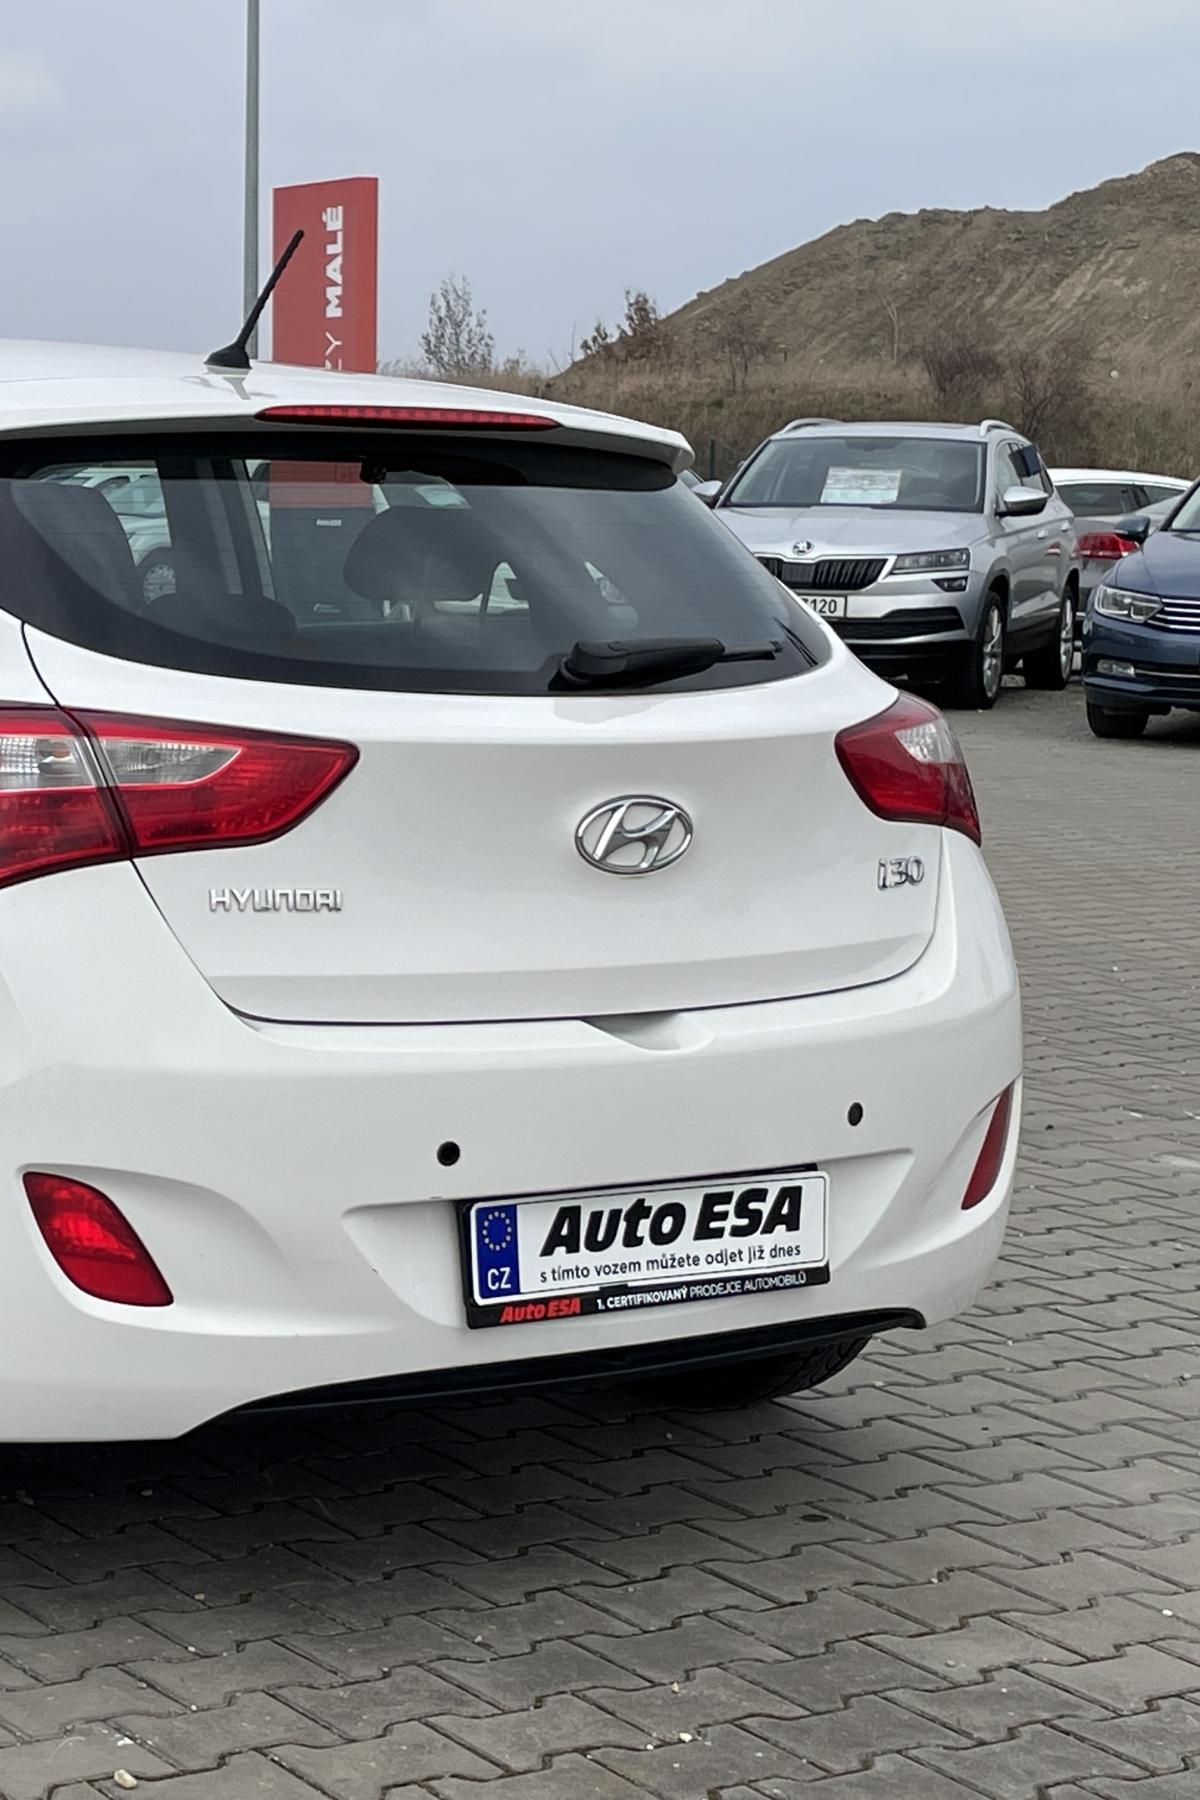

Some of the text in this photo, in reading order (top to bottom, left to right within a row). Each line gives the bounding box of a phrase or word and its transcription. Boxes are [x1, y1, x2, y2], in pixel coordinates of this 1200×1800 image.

[322, 205, 344, 319] MALÉ
[801, 598, 838, 614] 120
[877, 855, 925, 890] i30
[208, 888, 342, 912] HYUNDAI
[539, 1185, 803, 1258] Auto ESA
[540, 1243, 801, 1283] s tímto vozem můžete odjet již dnes
[487, 1266, 512, 1291] CZ
[500, 1297, 581, 1323] Auto ESA
[596, 1299, 606, 1310] 1.
[606, 1286, 688, 1309] CERTIFIKOVANÝ
[689, 1280, 743, 1298] PRODEJCE
